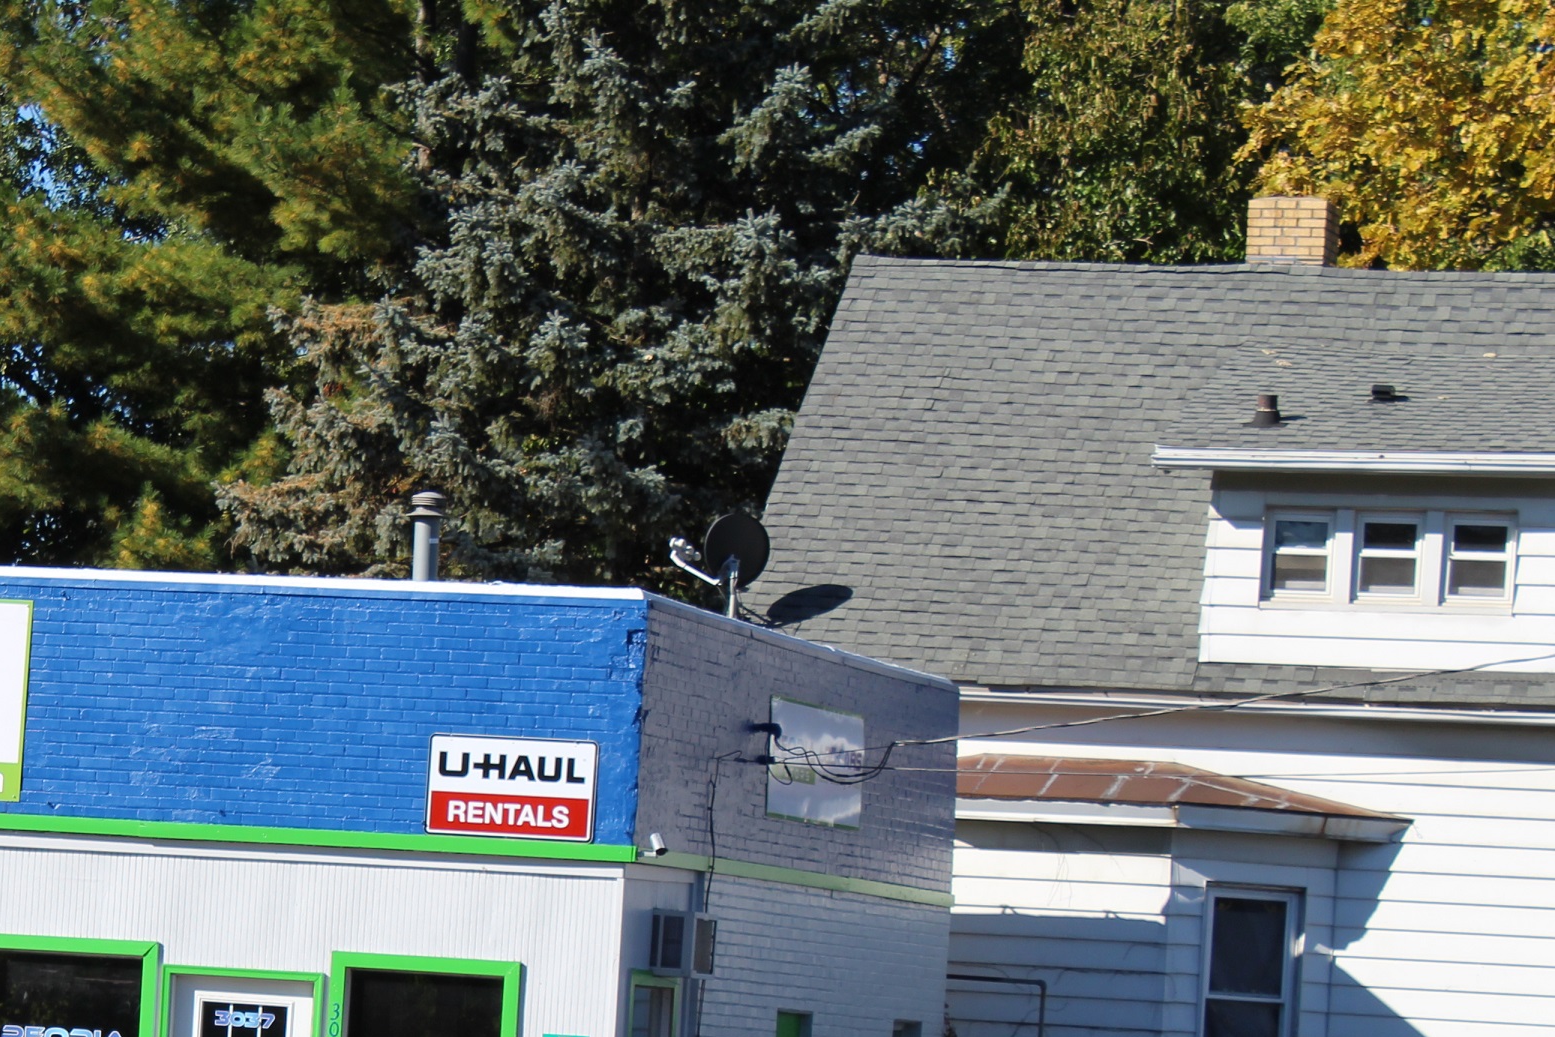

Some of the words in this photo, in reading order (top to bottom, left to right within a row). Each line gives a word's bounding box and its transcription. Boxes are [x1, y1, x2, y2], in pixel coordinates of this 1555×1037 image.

[439, 751, 585, 784] U-HAUL
[447, 800, 570, 828] RENTALS
[214, 1010, 275, 1029] 3037
